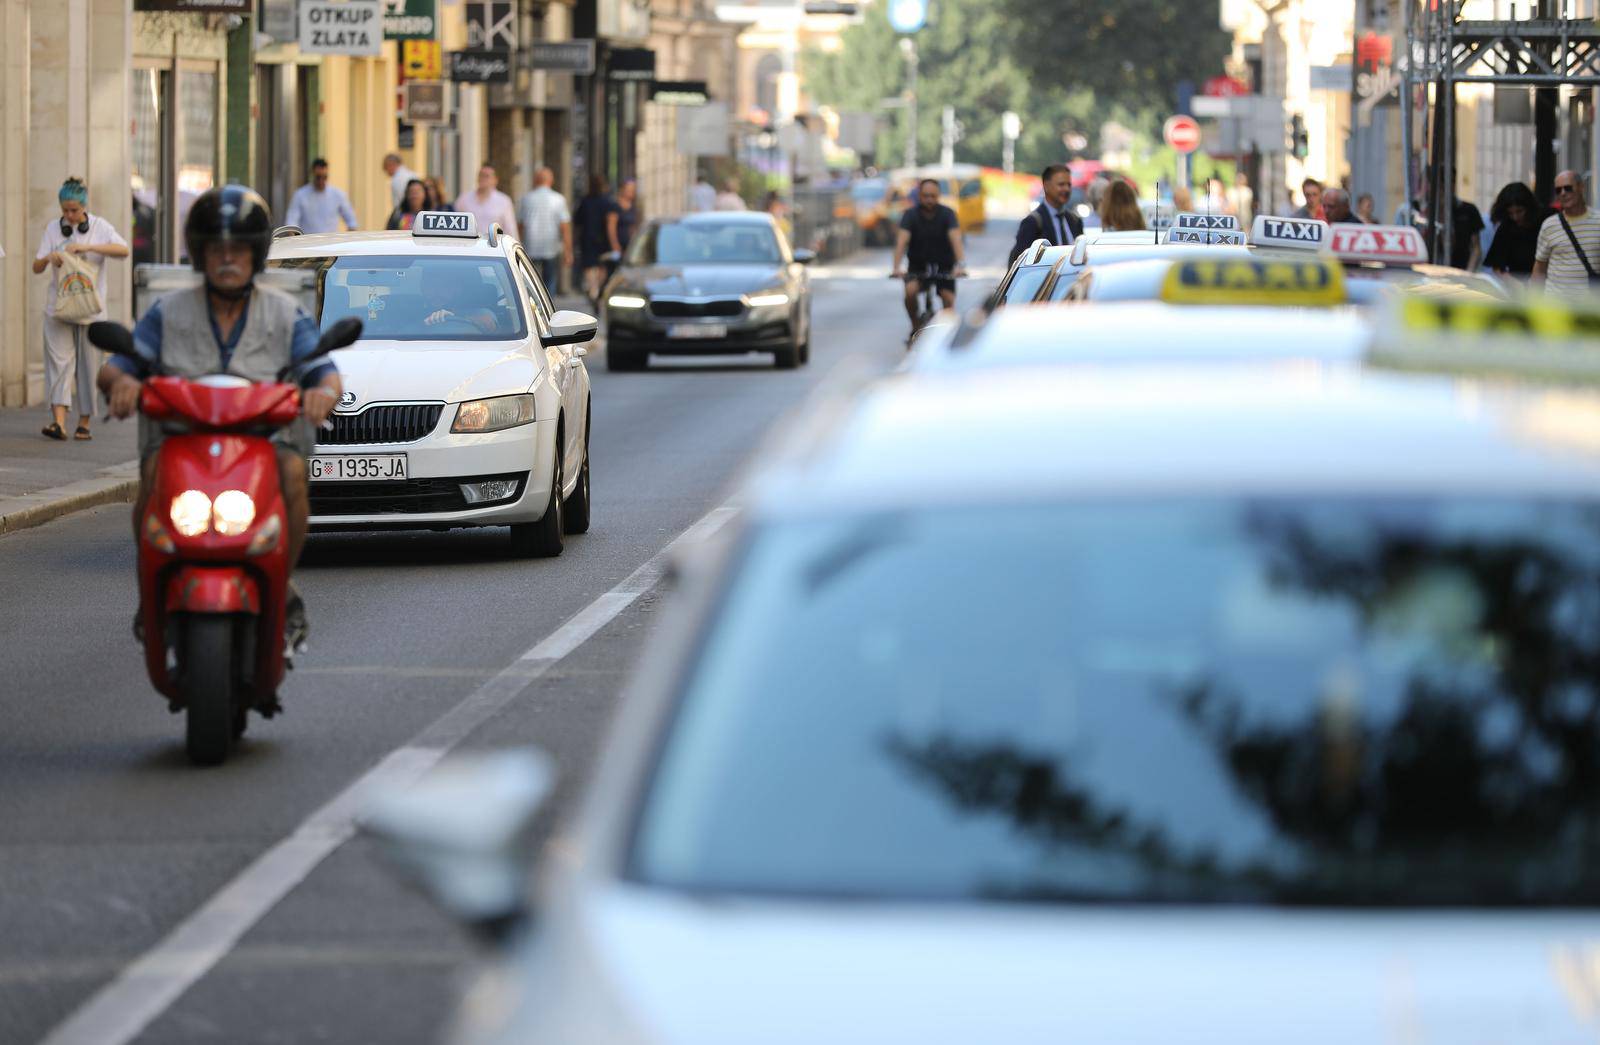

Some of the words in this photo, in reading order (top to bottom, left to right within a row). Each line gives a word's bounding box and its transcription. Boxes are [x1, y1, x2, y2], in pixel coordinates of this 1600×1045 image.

[309, 8, 373, 24] OTKUP
[312, 30, 369, 46] ZLATA
[426, 215, 466, 230] TAXI
[1182, 215, 1232, 228] TAXI
[1266, 220, 1319, 240] TAXI
[1337, 229, 1417, 254] TAXI
